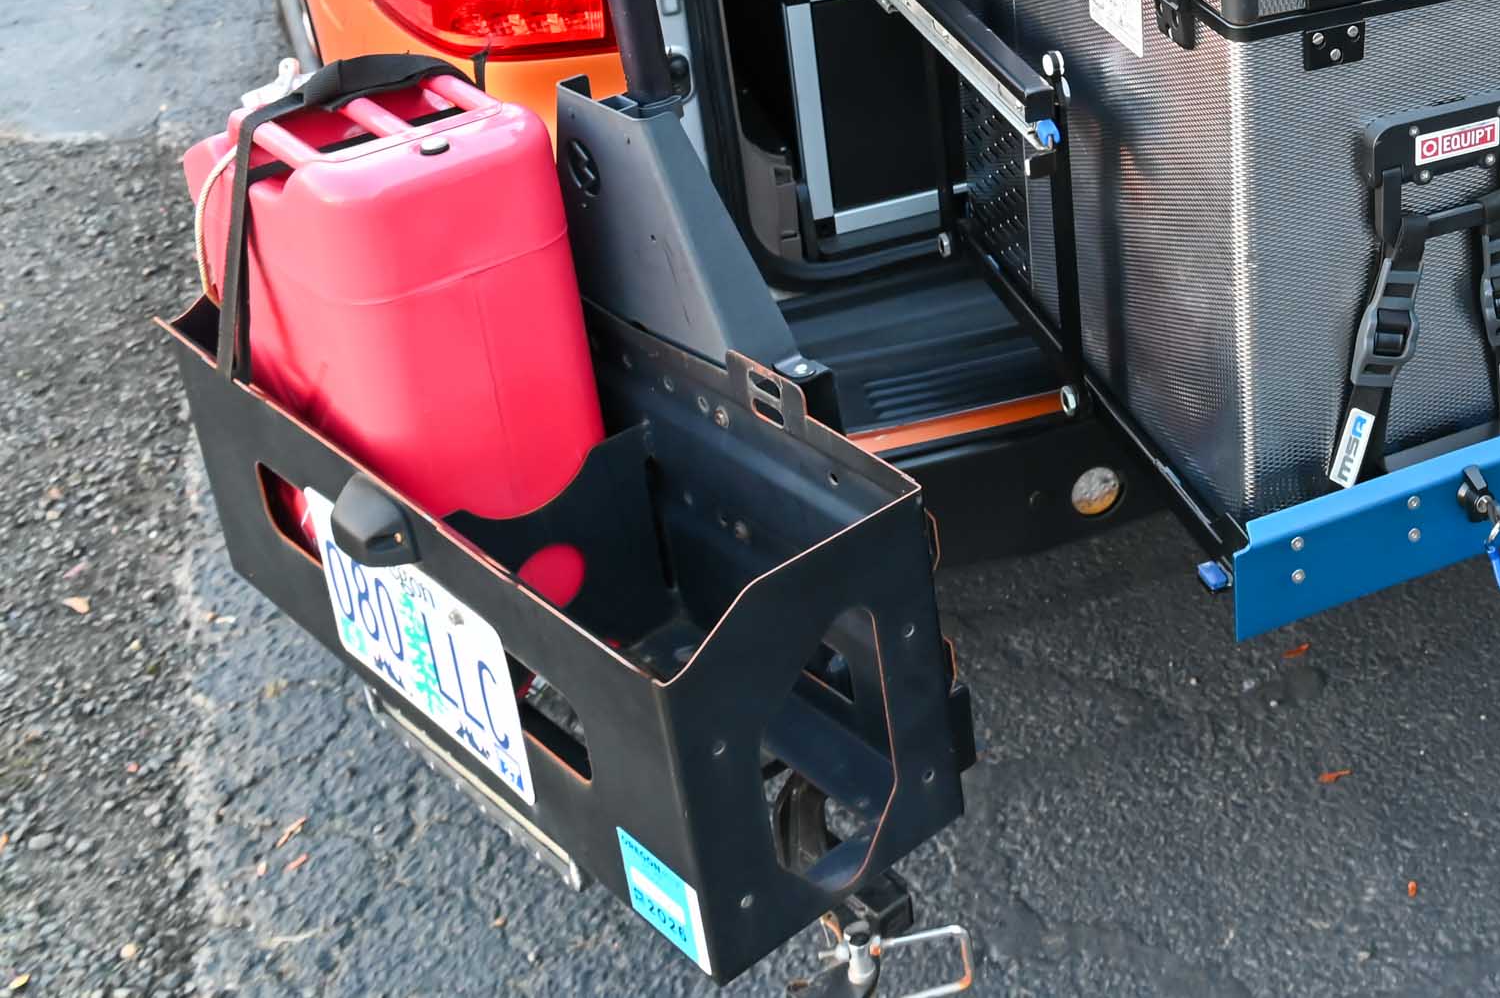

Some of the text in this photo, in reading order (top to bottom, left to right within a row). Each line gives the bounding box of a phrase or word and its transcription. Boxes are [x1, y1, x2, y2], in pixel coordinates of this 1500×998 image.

[1443, 126, 1495, 153] EQUIPT
[326, 539, 510, 751] 080 LLC
